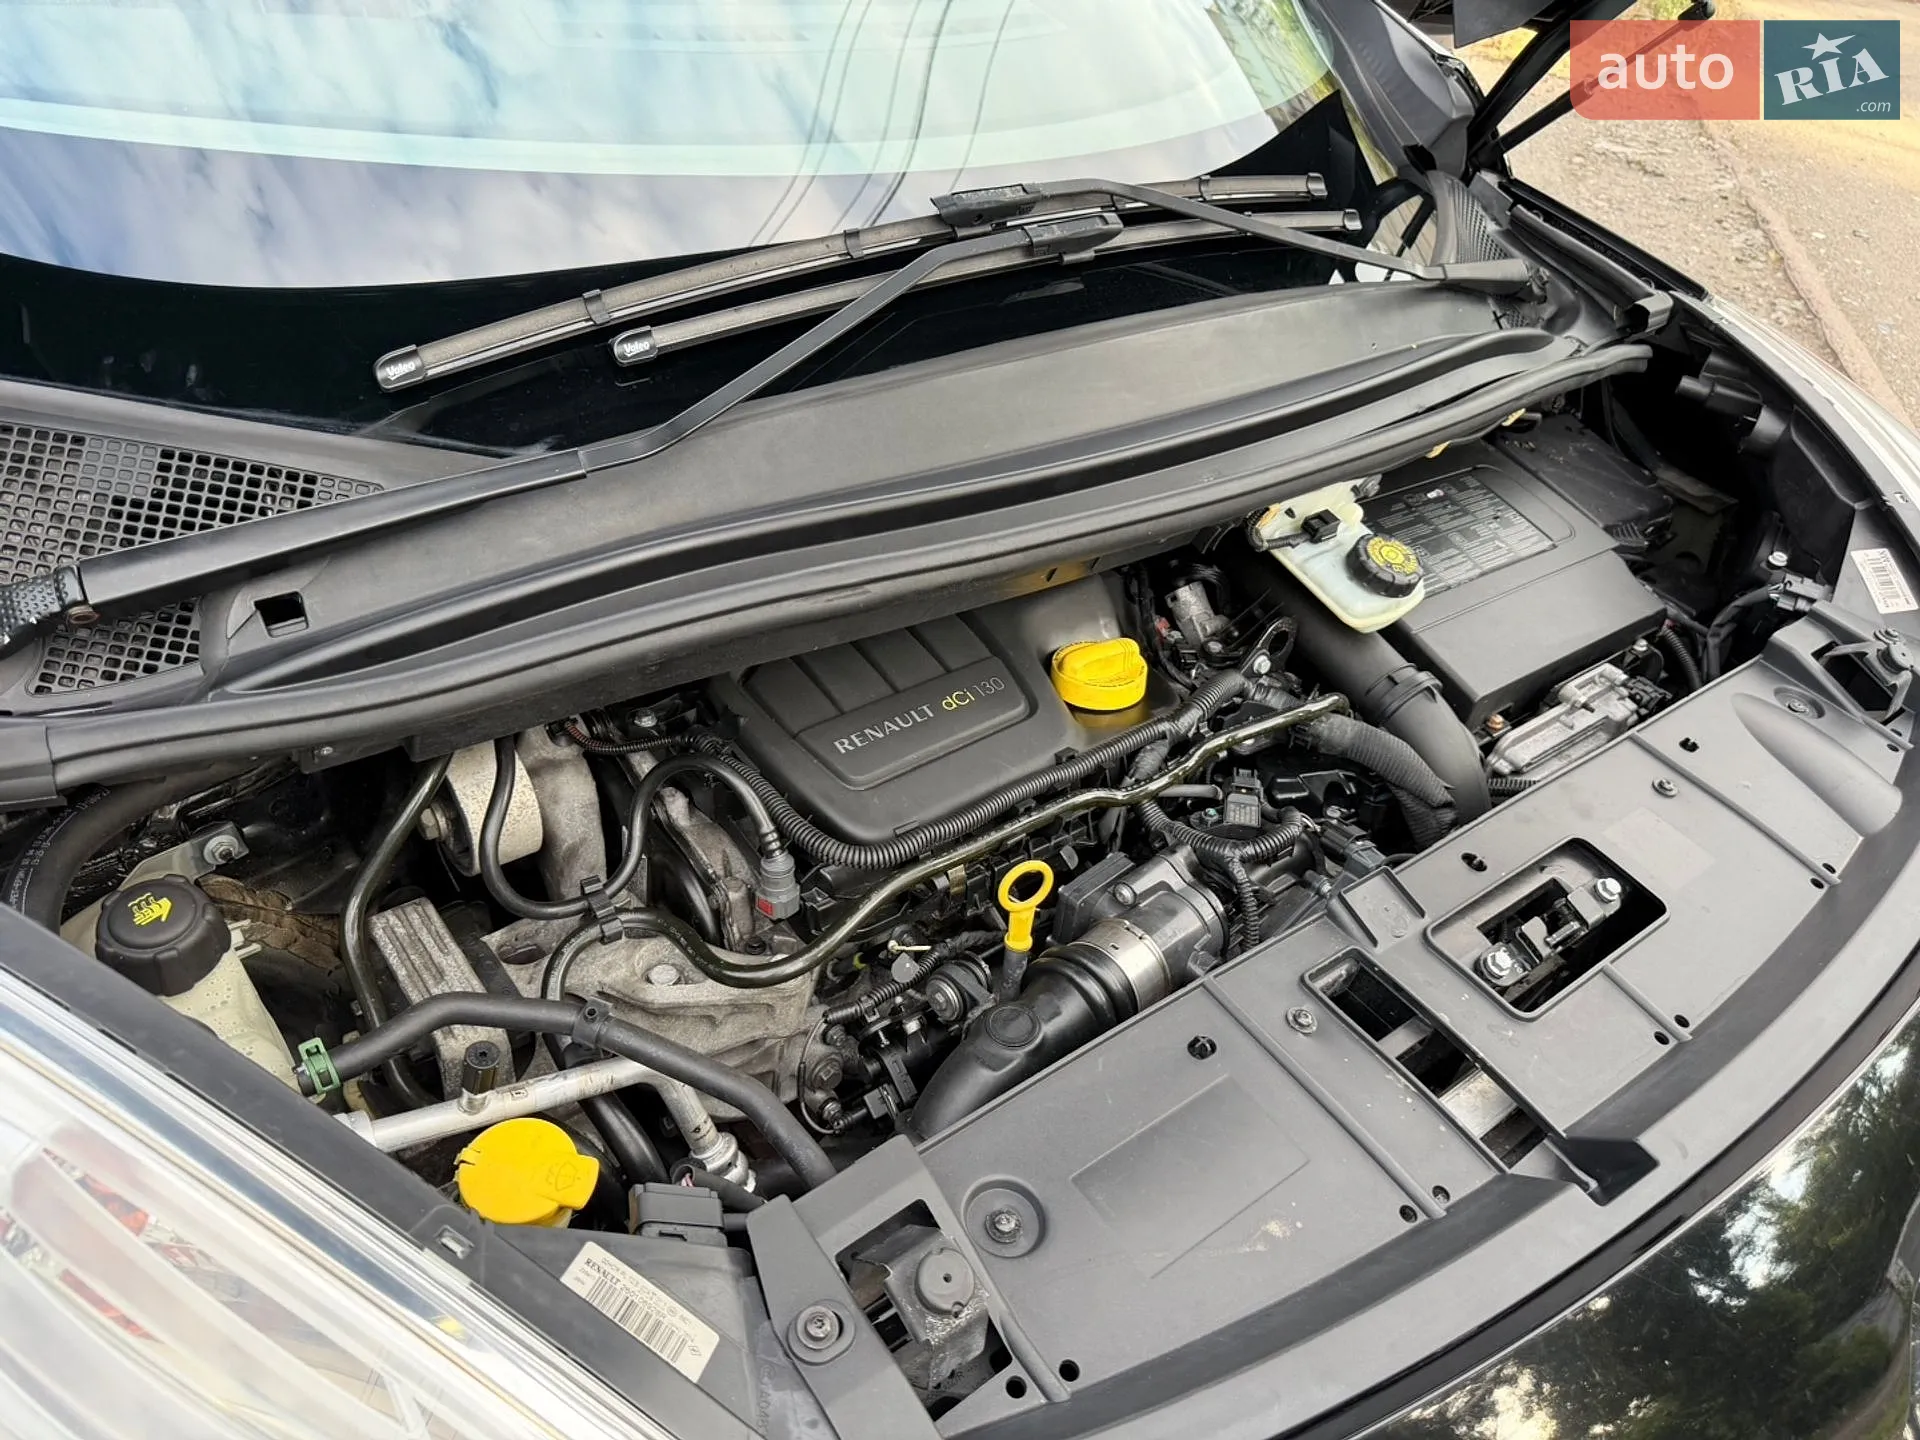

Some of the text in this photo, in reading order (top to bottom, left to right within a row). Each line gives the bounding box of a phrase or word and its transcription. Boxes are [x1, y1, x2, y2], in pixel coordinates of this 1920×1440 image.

[624, 341, 650, 354] Valeo
[386, 361, 416, 377] Valeo
[833, 677, 1005, 754] RENAULT dCi 130
[584, 1257, 621, 1287] RENAULT
